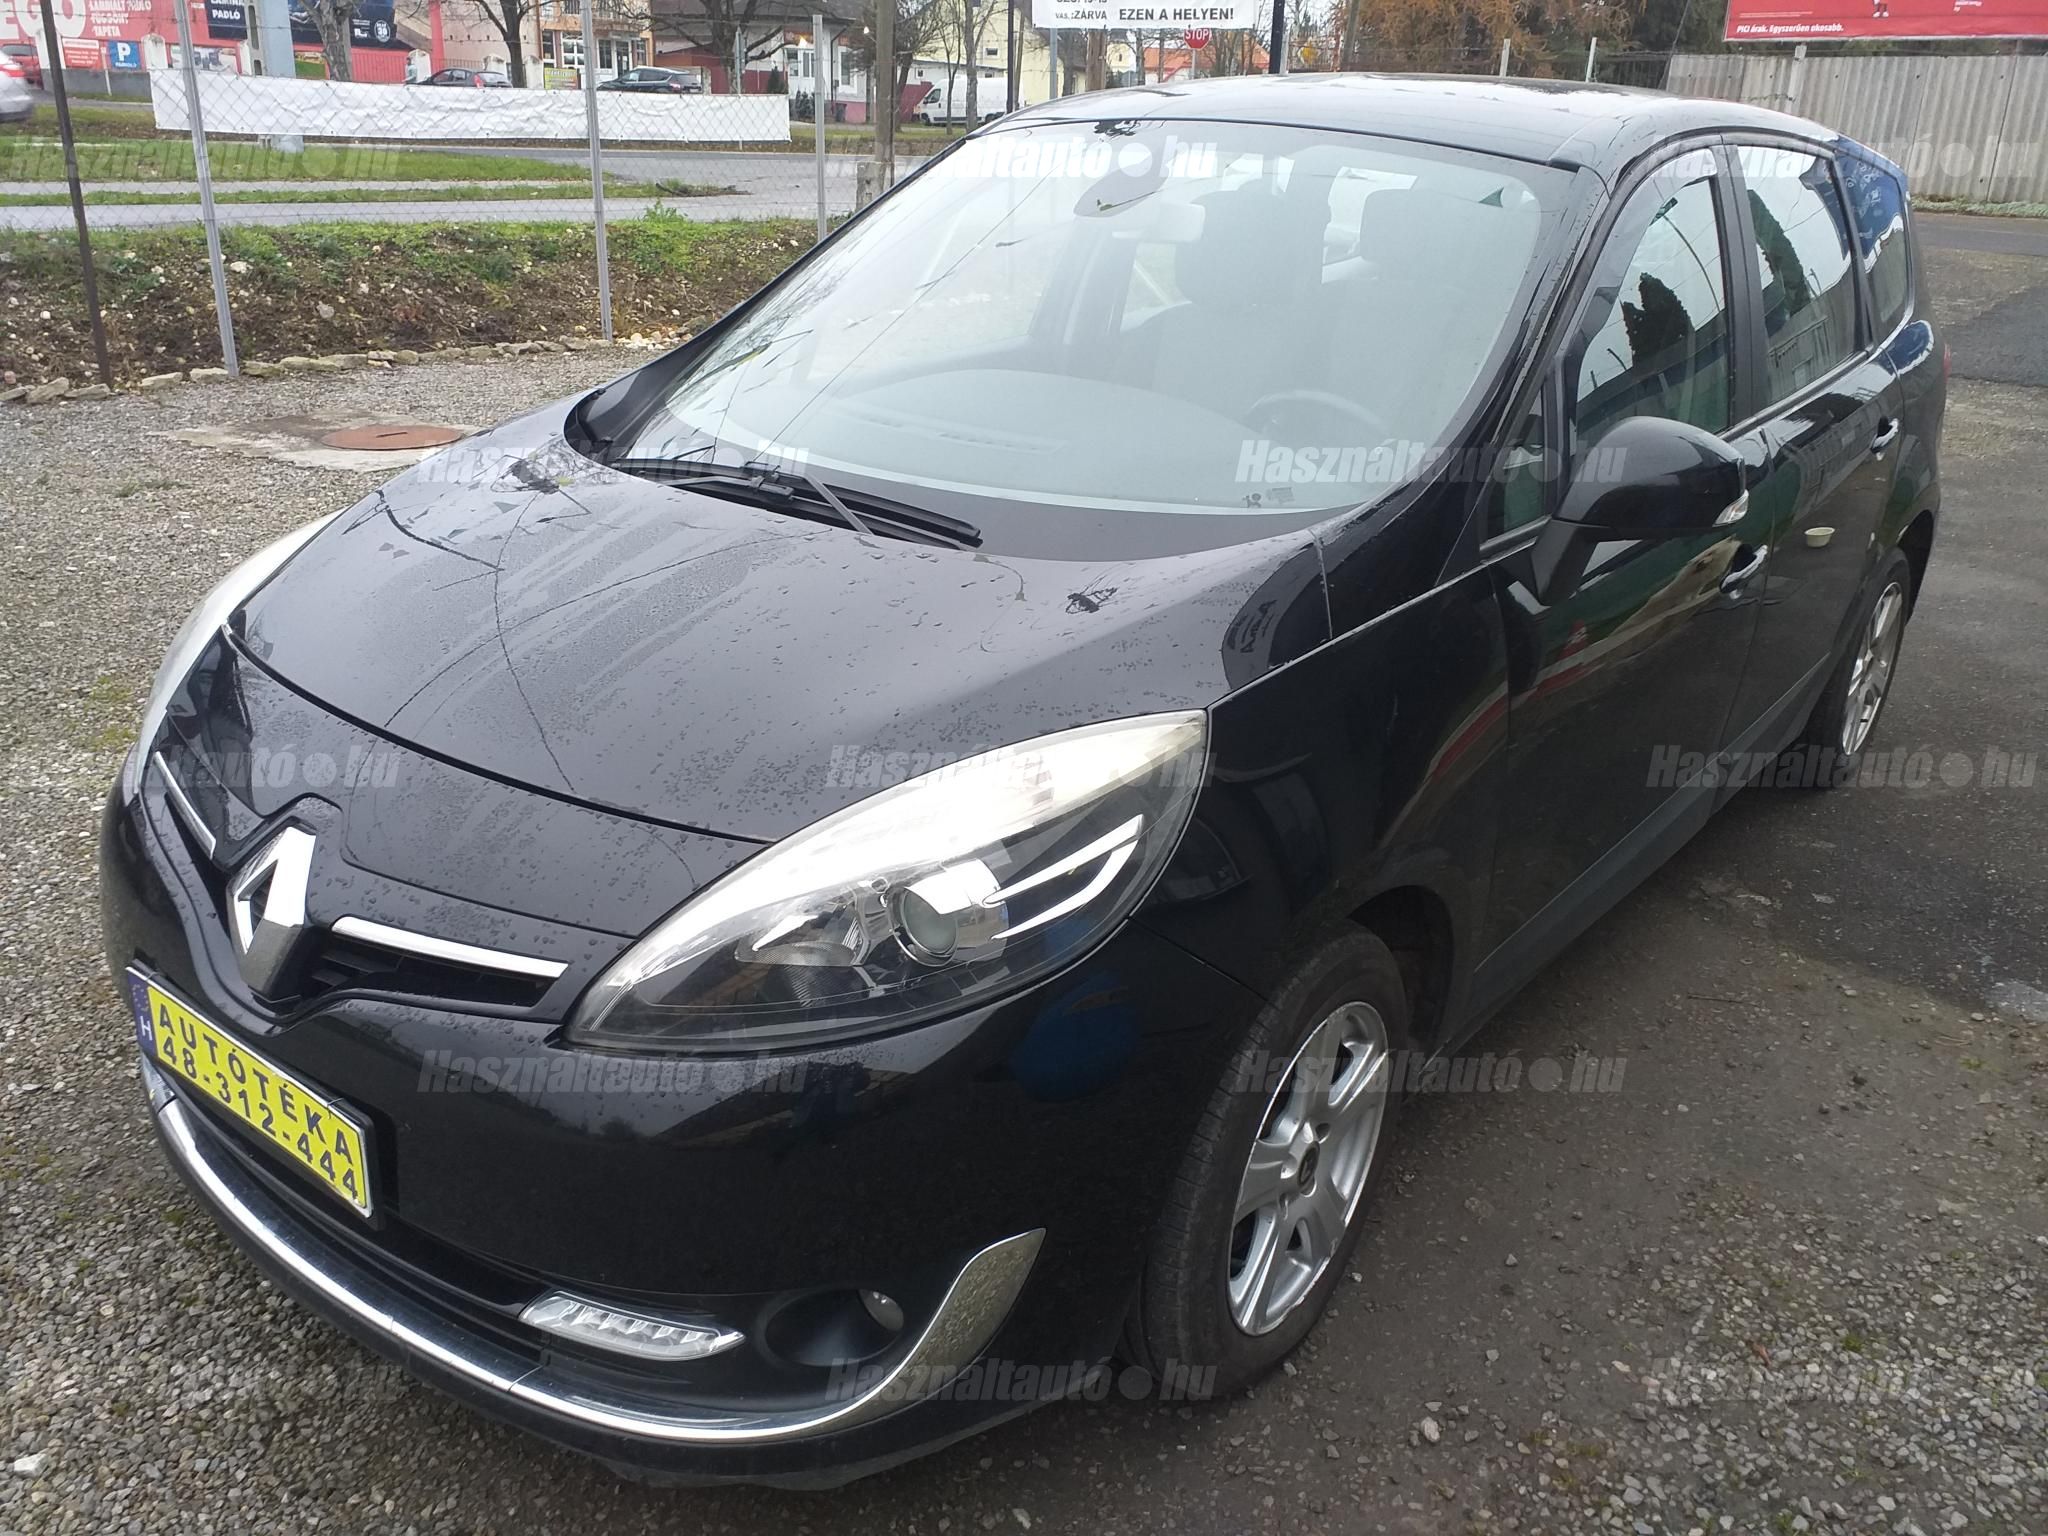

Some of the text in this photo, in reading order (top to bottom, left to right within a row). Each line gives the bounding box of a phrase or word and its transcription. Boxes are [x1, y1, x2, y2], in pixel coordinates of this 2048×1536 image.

[212, 9, 241, 20] PADLÓ
[1119, 8, 1234, 20] EZEN A HELYEN!
[1185, 28, 1209, 41] STOP
[159, 1003, 354, 1167] AUTÓTÉKA
[162, 1036, 359, 1201] 48-312-444
